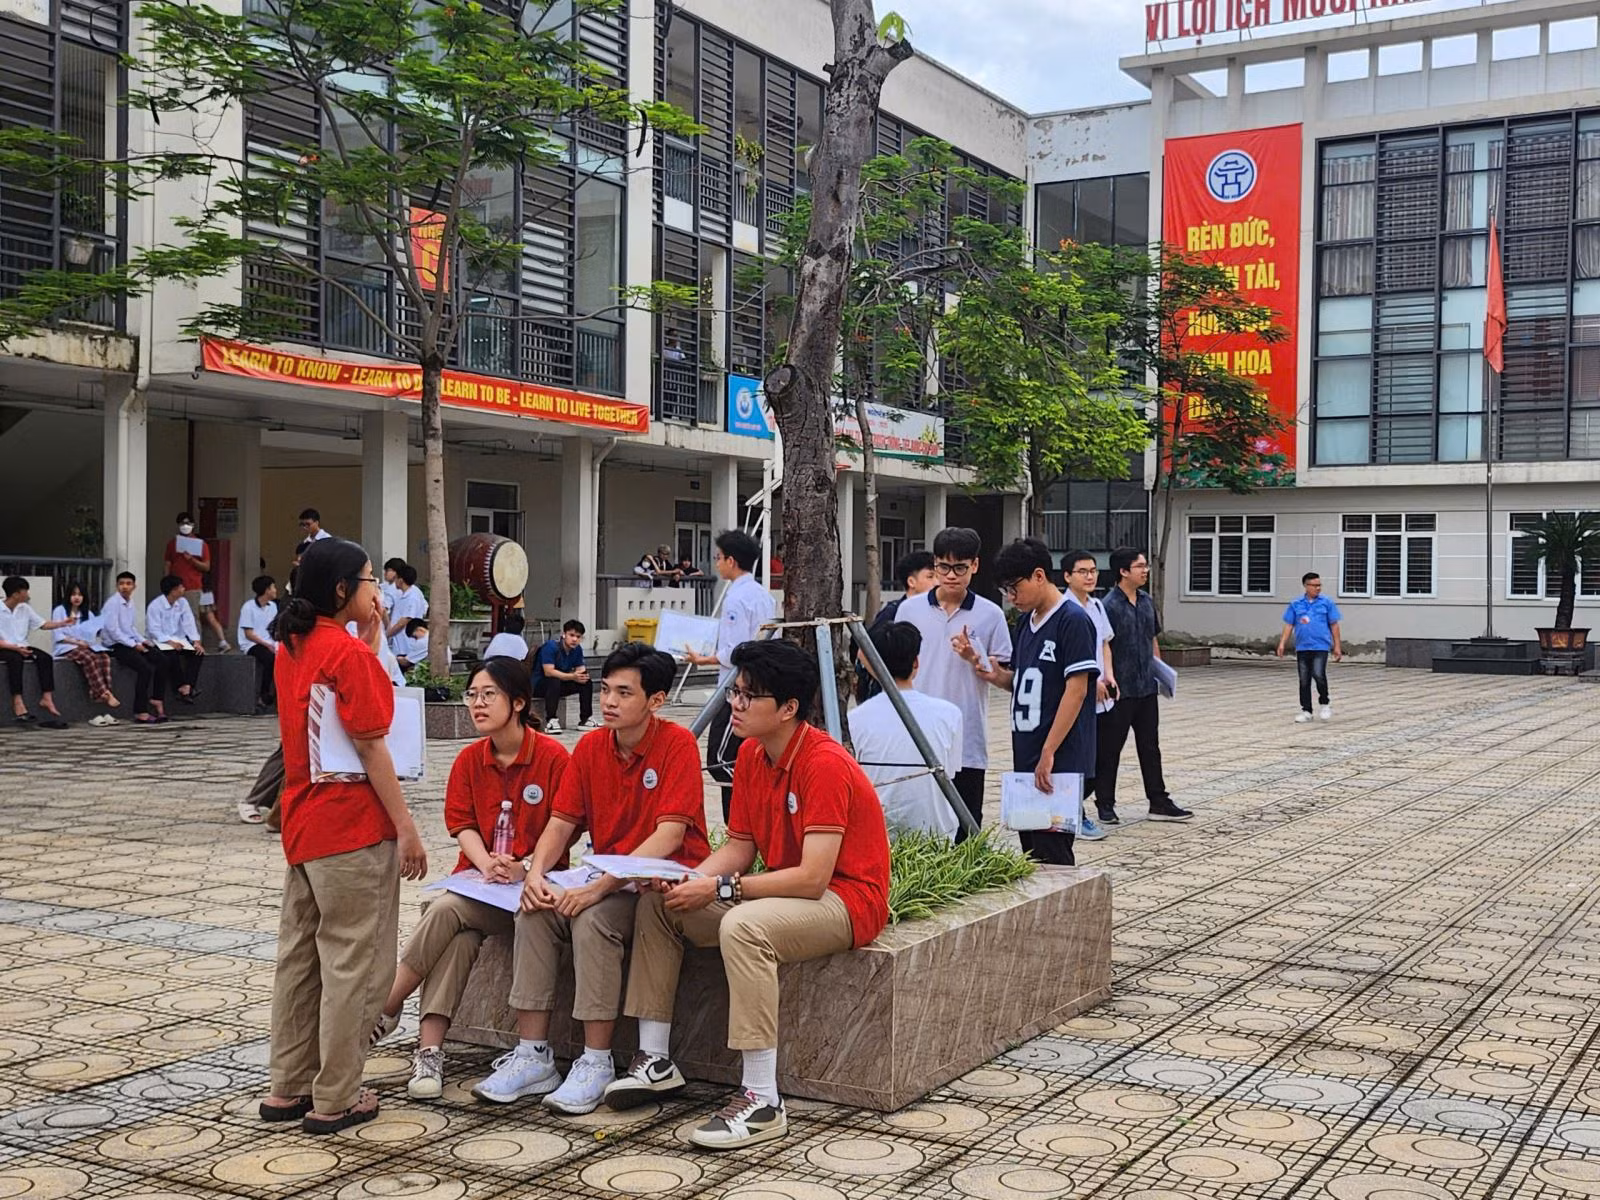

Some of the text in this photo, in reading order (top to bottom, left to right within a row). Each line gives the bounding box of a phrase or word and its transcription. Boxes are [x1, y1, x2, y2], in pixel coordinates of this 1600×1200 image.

[1186, 220, 1226, 252] RÈN
[1232, 349, 1273, 376] HOA
[221, 346, 273, 373] LEARN
[275, 355, 295, 375] TO
[297, 359, 343, 381] KNOW
[351, 368, 393, 388] LEARN
[395, 372, 412, 390] TO
[440, 378, 477, 402] LEARN
[480, 385, 494, 402] TO
[496, 388, 511, 405] BE
[520, 391, 552, 412] LEARN
[555, 398, 568, 414] TO
[570, 400, 591, 418] LIVE
[592, 406, 638, 425] TOGETHER
